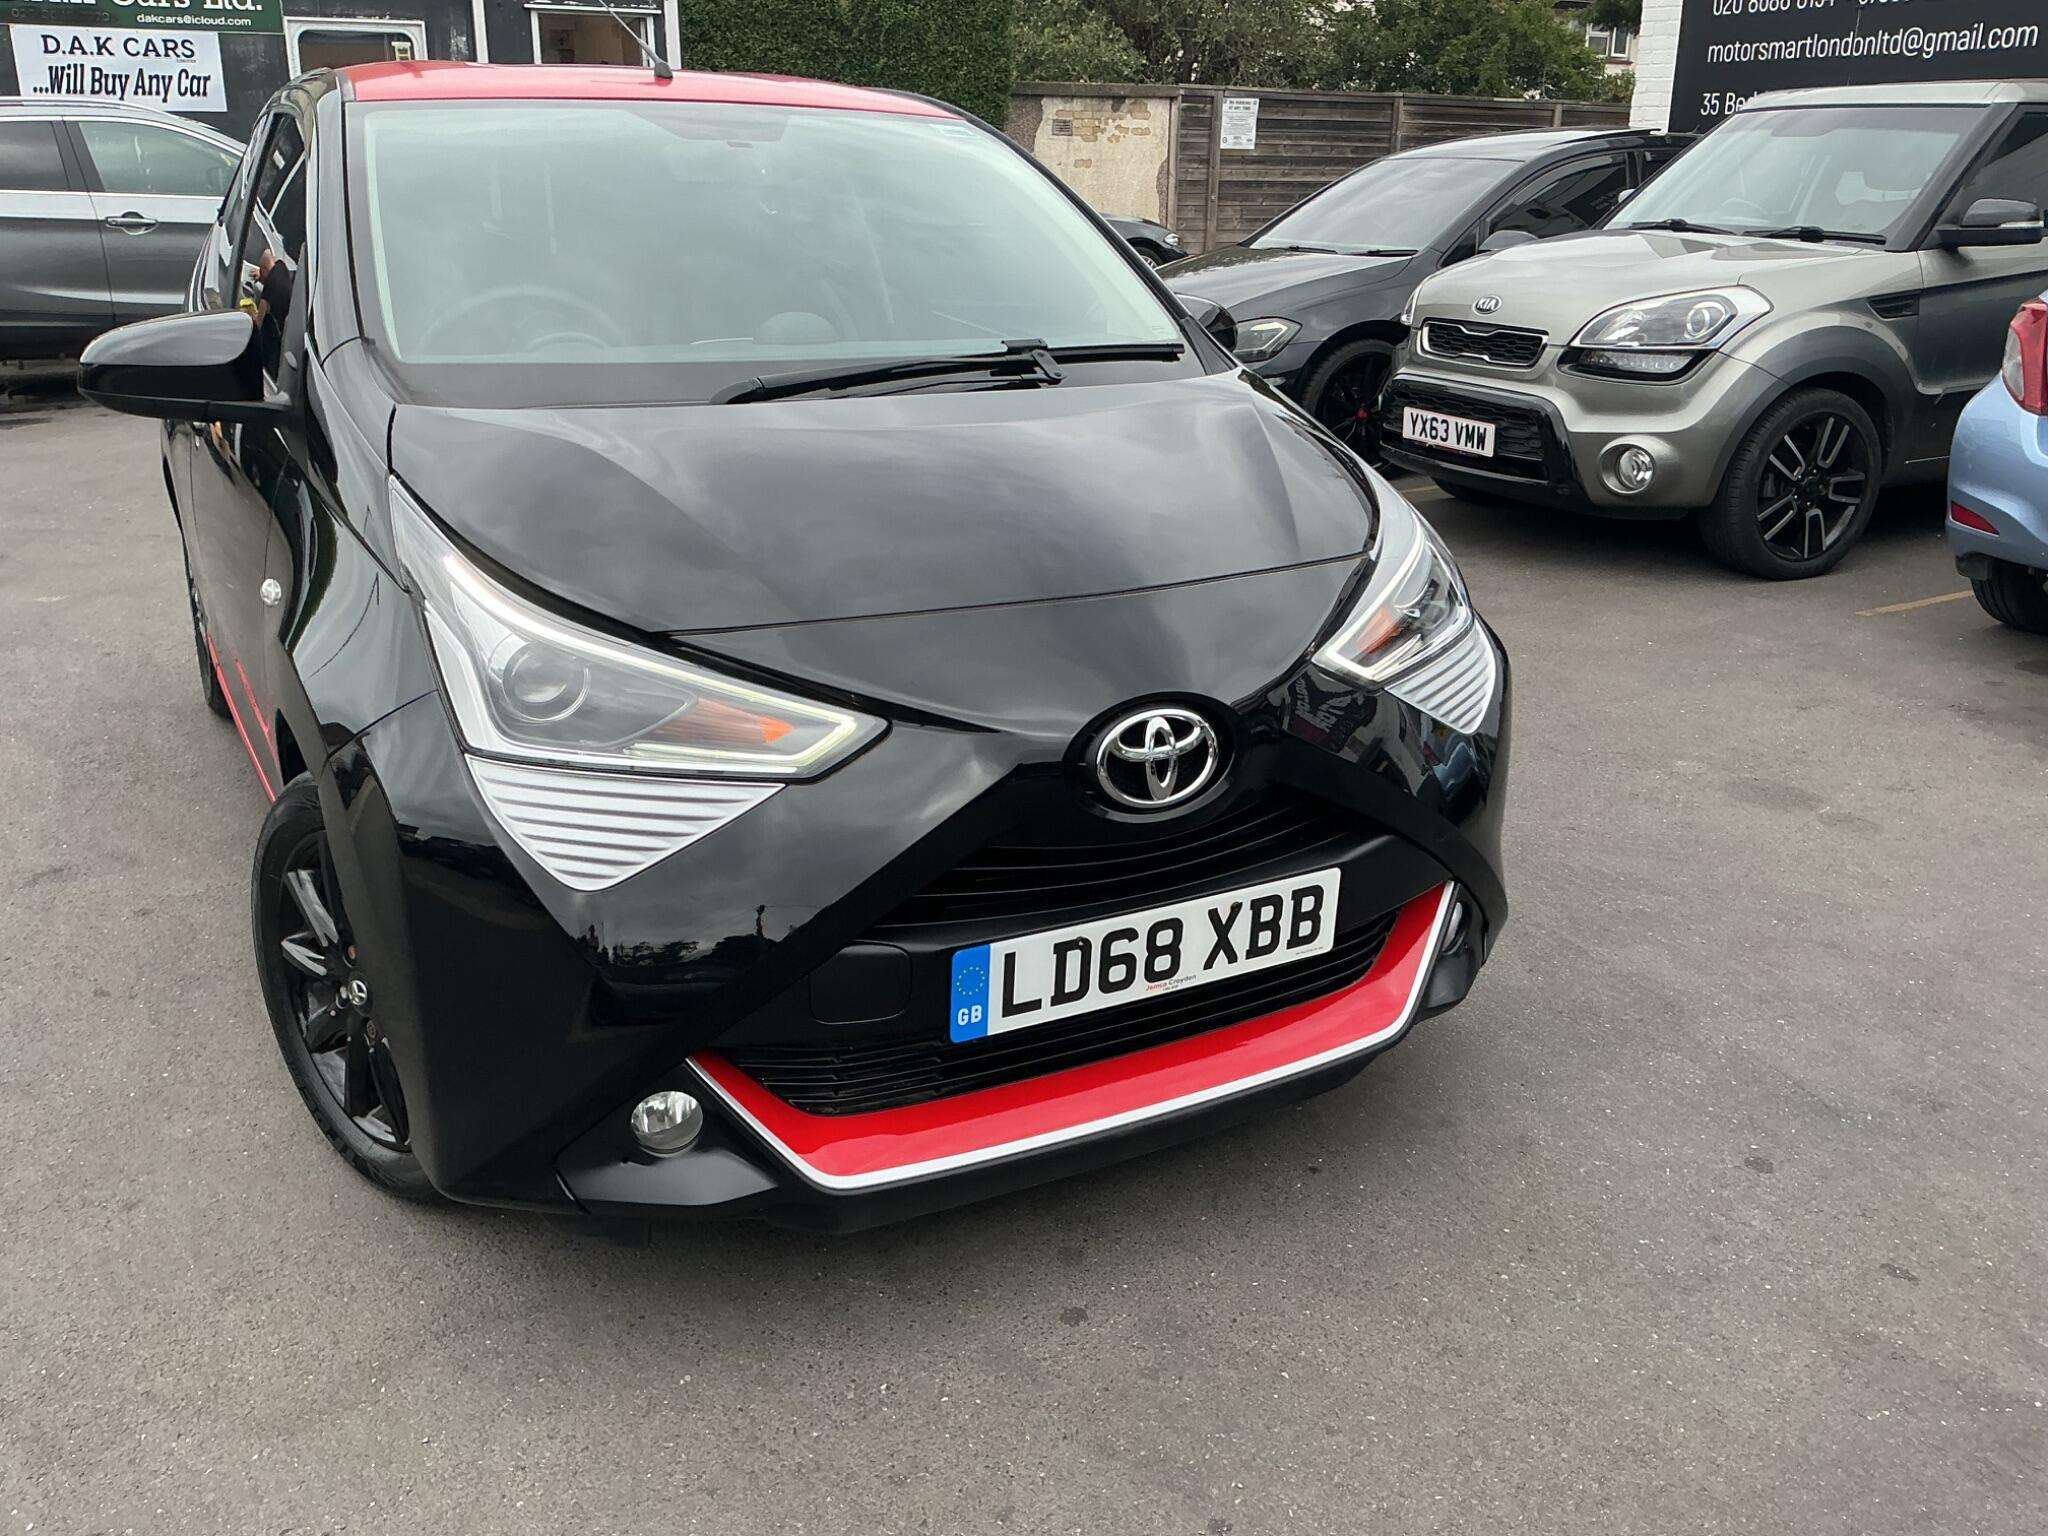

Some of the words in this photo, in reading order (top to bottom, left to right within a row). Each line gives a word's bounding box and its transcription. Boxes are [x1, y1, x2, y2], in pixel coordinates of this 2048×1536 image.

[112, 0, 193, 9] ars
[136, 13, 251, 26] dakcars@icloud.com
[41, 34, 115, 56] D.A.K
[123, 37, 195, 59] CARS
[1707, 22, 2039, 64] motorsmartlondonltd@gmail.com
[90, 66, 130, 100] Buy
[133, 67, 173, 103] Any
[177, 68, 211, 98] Car
[1700, 92, 1720, 116] 35
[1477, 298, 1496, 310] KIA
[1410, 411, 1449, 442] YX63
[1455, 421, 1487, 451] VMW
[1001, 916, 1184, 1018] LD68
[1203, 884, 1324, 970] XBB
[957, 1004, 982, 1026] GB
